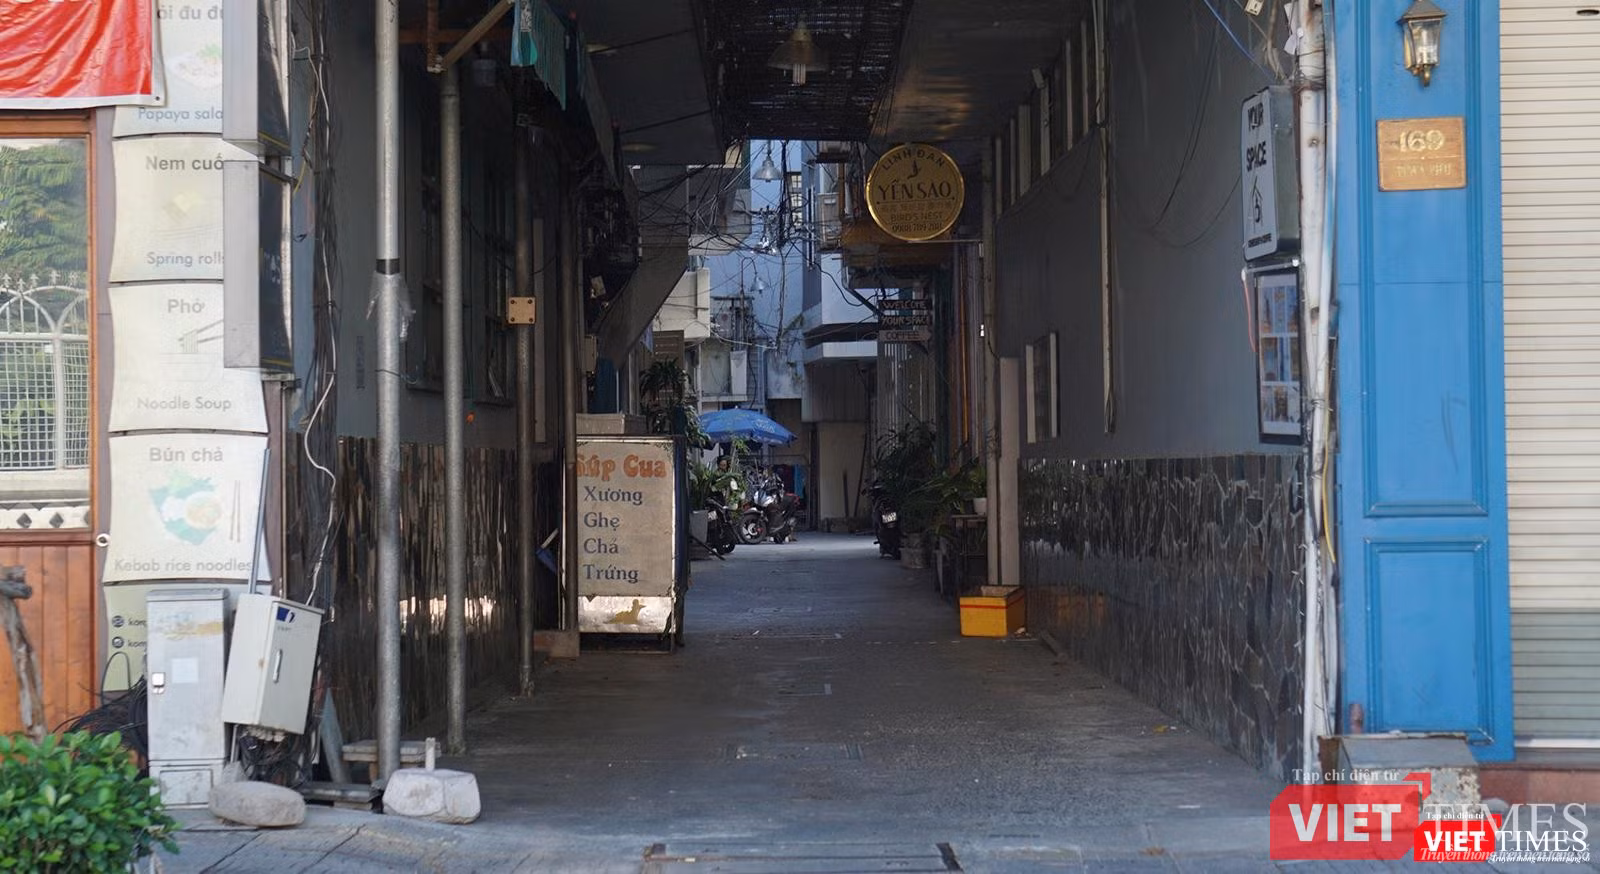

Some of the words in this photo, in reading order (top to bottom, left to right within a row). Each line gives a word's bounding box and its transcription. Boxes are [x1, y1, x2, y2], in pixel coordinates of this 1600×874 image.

[207, 4, 223, 20] đ
[138, 107, 190, 122] Papaya
[194, 106, 223, 120] sala
[1248, 102, 1264, 131] YOUR
[1399, 129, 1445, 152] 169
[146, 155, 186, 170] Nem
[882, 148, 912, 171] LINH
[1246, 140, 1267, 172] SPACE
[146, 251, 193, 268] Spring
[198, 251, 223, 265] roll
[167, 297, 205, 314] Phở
[137, 396, 191, 410] Noodle
[195, 396, 232, 412] Soup
[149, 447, 186, 462] Bún
[623, 454, 667, 478] Cua
[583, 511, 620, 532] Ghẹ
[114, 558, 160, 572] Kebab
[165, 559, 191, 572] rice
[196, 558, 253, 572] noodles
[582, 564, 639, 584] Trứng
[128, 618, 147, 628] kom
[128, 639, 147, 648] kom
